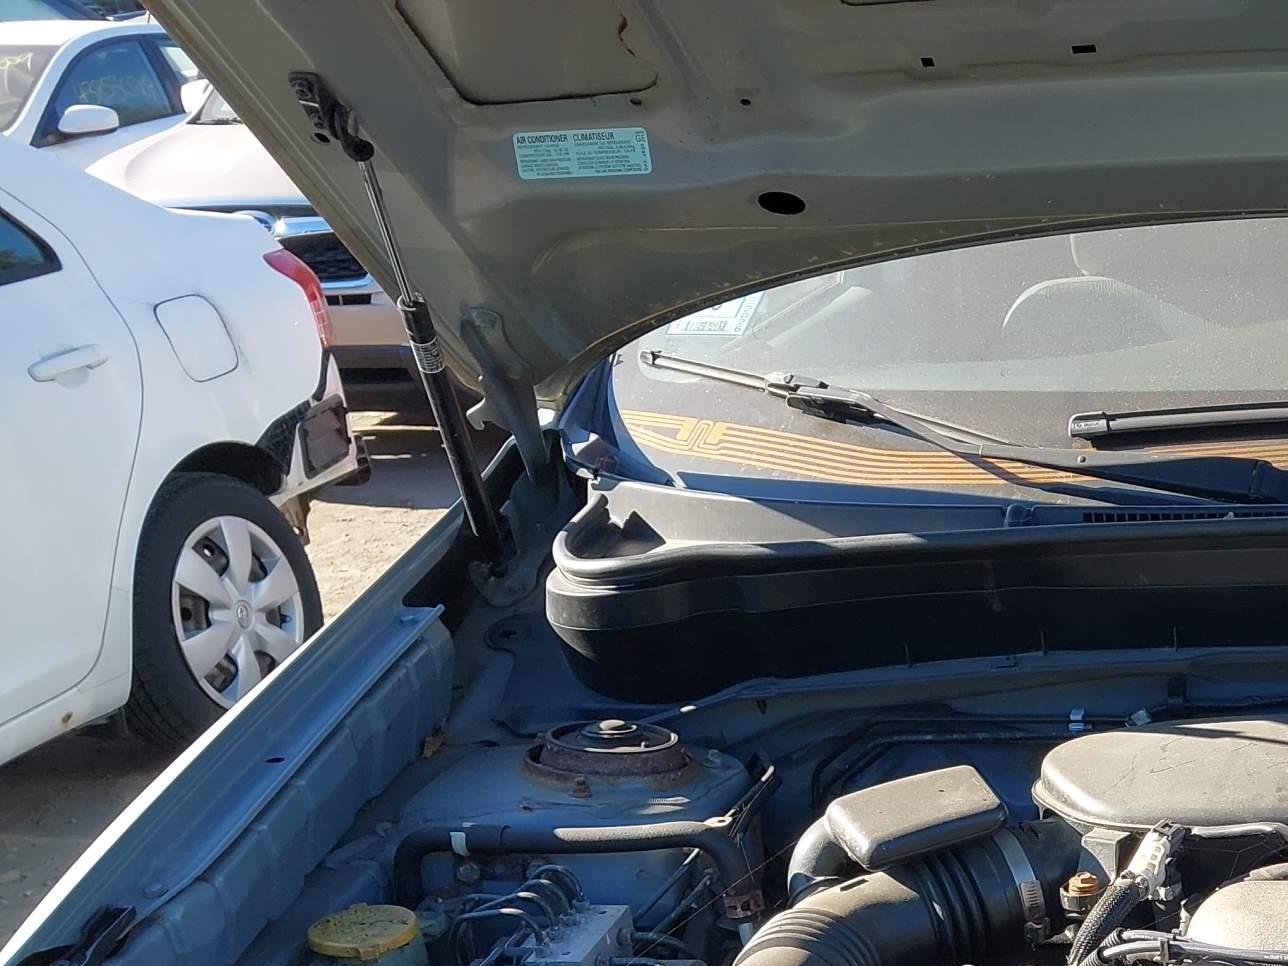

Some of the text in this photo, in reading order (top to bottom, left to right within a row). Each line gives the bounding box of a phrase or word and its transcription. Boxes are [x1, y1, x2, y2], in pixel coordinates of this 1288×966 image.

[516, 134, 568, 145] AIR CONDITIONER
[572, 132, 615, 142] CLIMATISEUR
